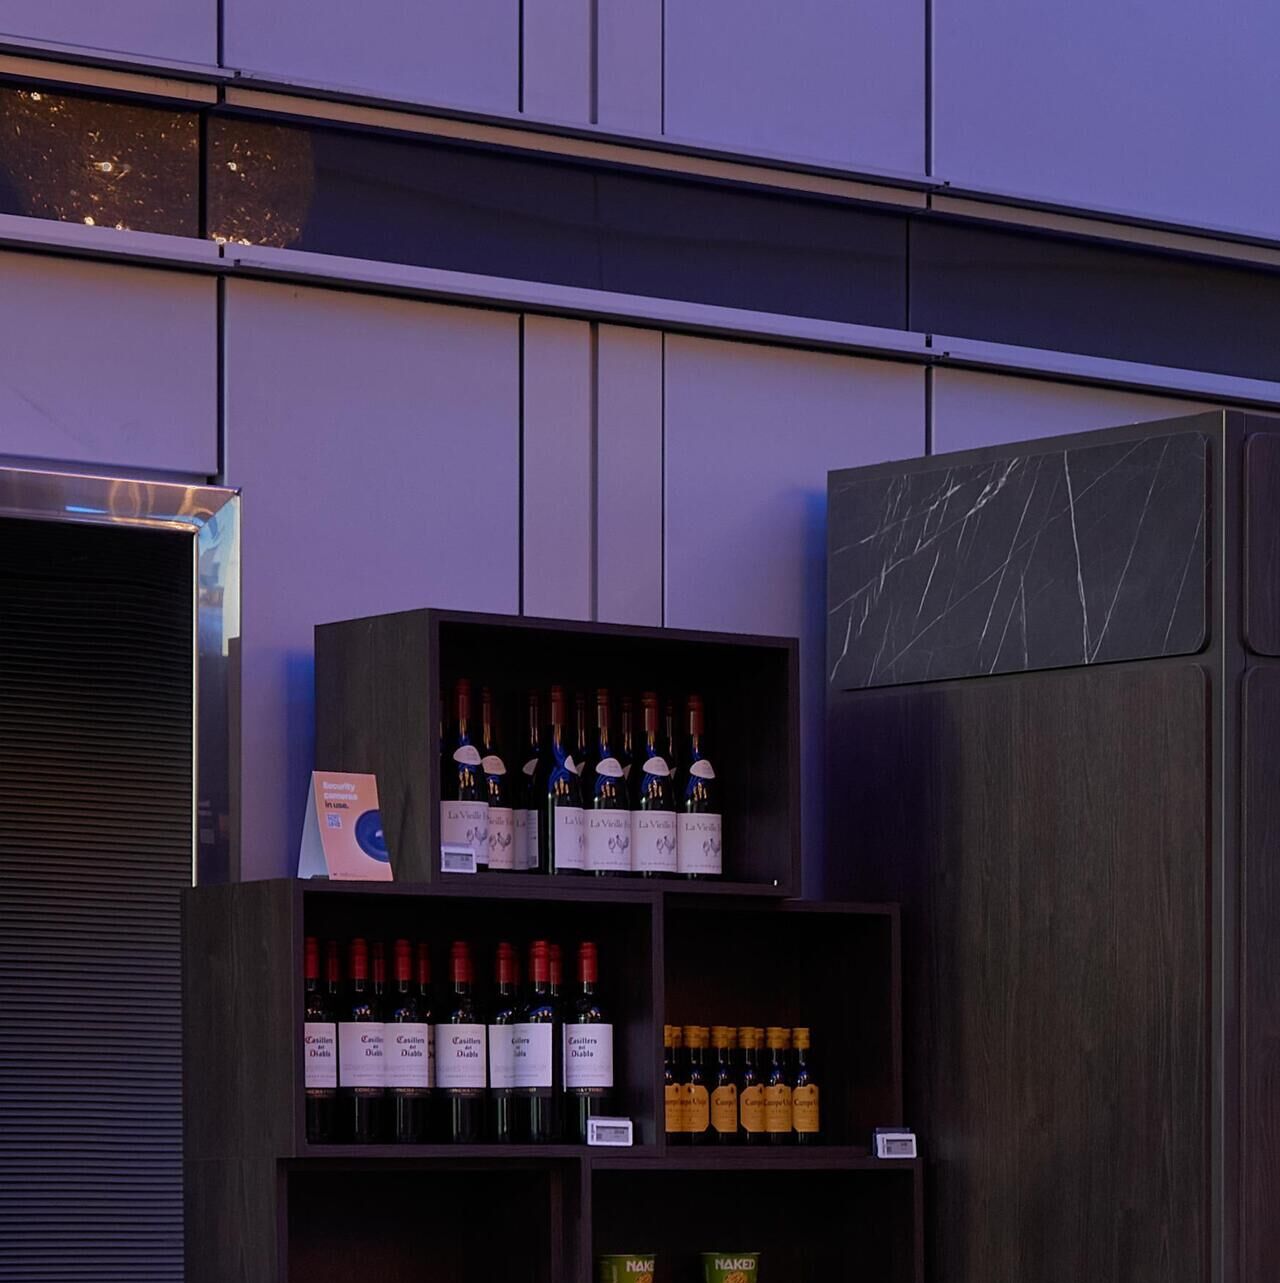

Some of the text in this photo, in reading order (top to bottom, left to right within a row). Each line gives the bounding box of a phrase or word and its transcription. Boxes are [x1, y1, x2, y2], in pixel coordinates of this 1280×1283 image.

[322, 781, 356, 792] Security
[324, 801, 333, 809] in
[714, 1259, 756, 1271] NAKED
